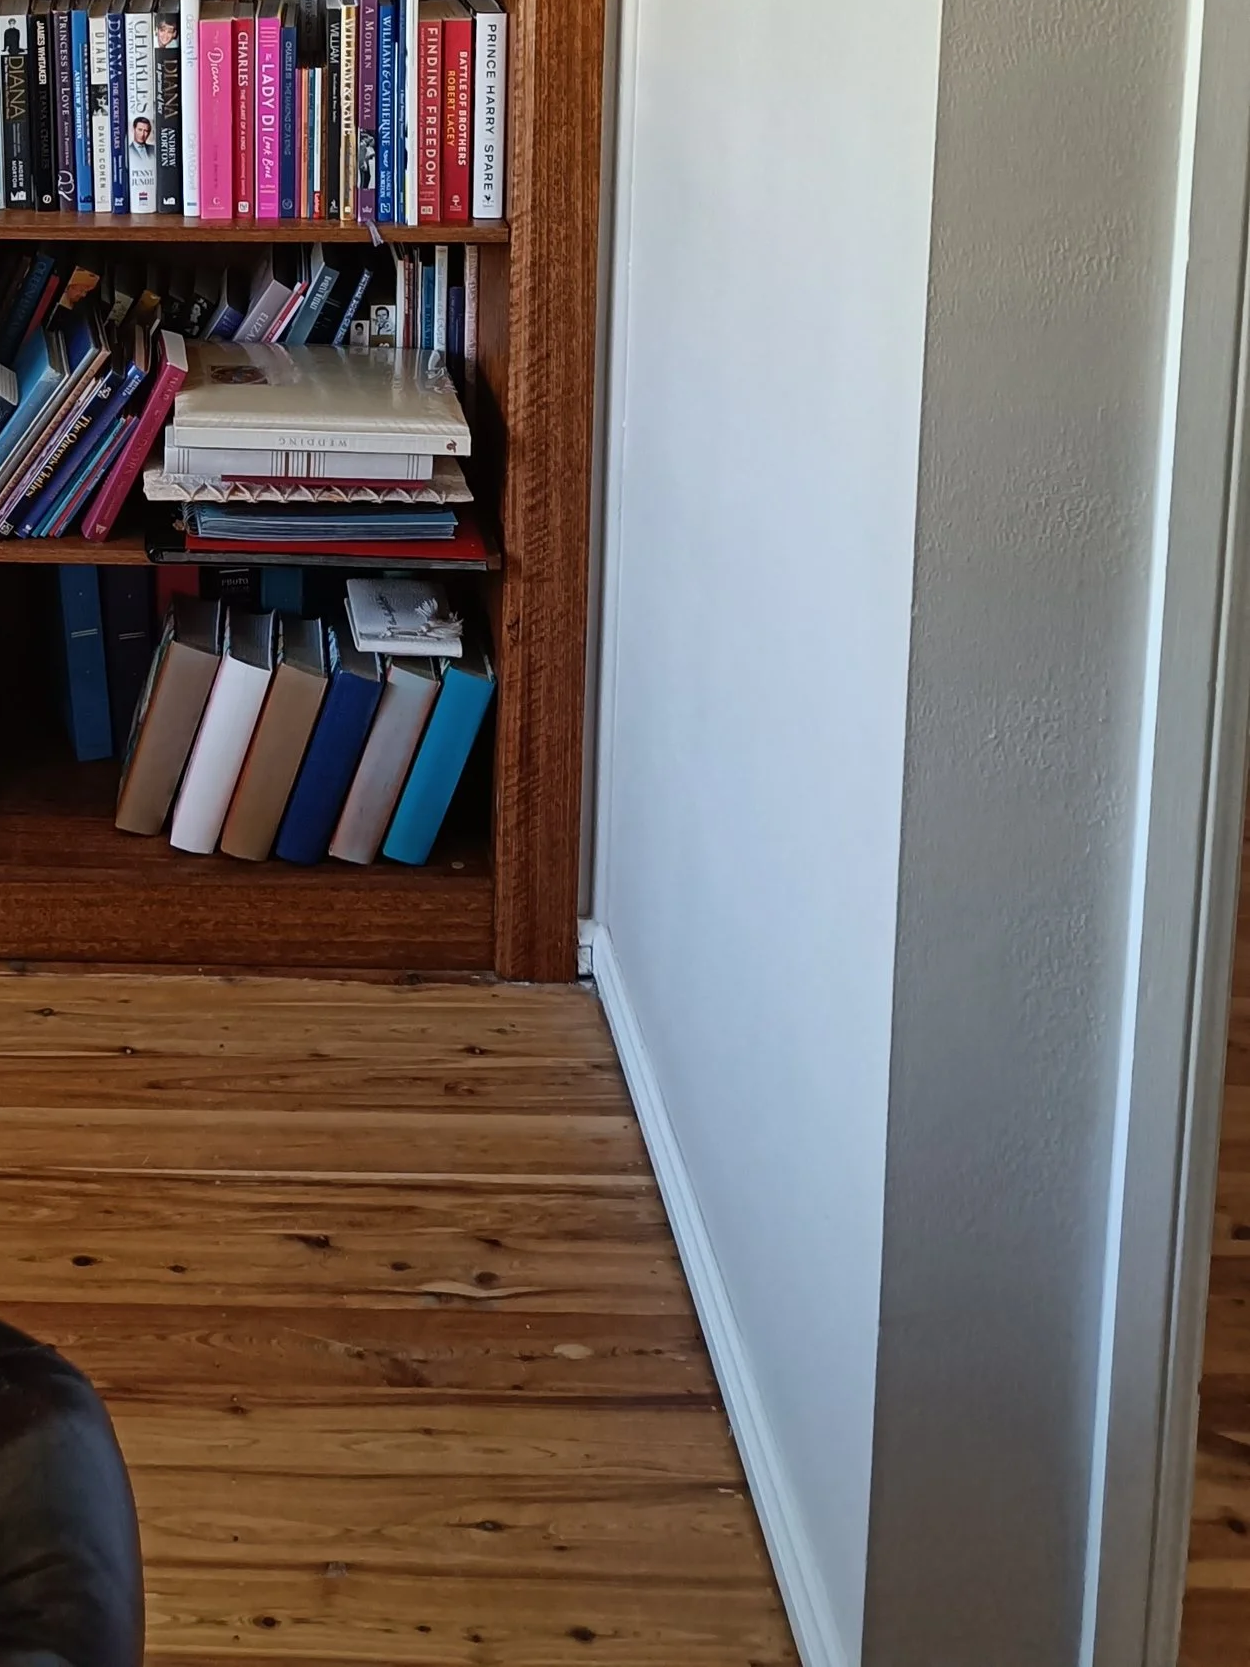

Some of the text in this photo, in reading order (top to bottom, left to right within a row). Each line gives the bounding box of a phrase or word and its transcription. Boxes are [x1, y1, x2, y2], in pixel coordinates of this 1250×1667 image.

[36, 20, 46, 84] JAMES WHITAKER
[58, 15, 69, 115] PRINCESS IN LOVE
[95, 31, 106, 73] DIANA
[108, 19, 121, 79] DIANA
[130, 20, 152, 113] CHARLES
[206, 47, 223, 95] Diana
[364, 20, 373, 68] MODERN
[7, 55, 25, 118] DIANA
[163, 60, 177, 118] DIANA
[363, 84, 373, 119] ROYAL
[378, 15, 391, 146] WILLIAM & CATHERINE
[424, 27, 437, 184] FINDING FREEDOM
[446, 70, 455, 146] ROBERT LACEY
[457, 51, 467, 165] BATTLE OF BROTHERS
[482, 24, 497, 190] PRINCE HARRY SPARE
[98, 158, 106, 188] COHEN
[160, 128, 168, 166] MORTON
[277, 437, 348, 448] WEDDING
